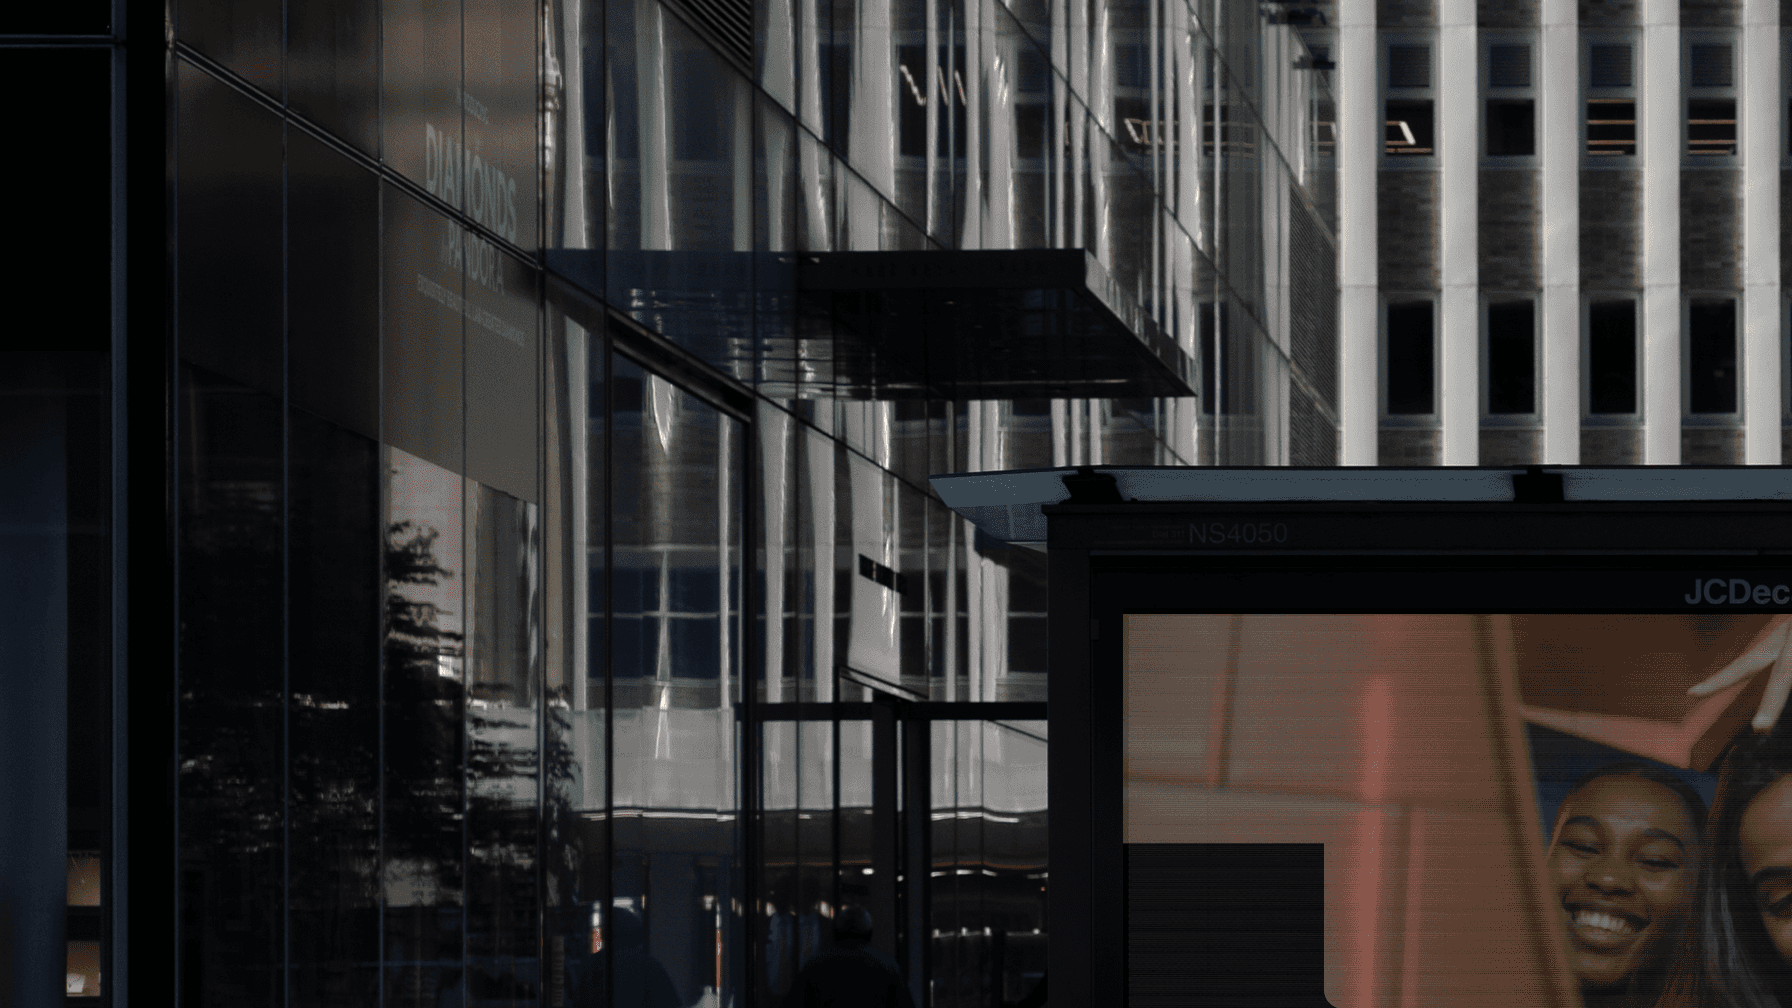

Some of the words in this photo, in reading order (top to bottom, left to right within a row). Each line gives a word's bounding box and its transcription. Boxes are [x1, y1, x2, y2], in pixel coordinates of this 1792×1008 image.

[425, 122, 518, 244] DIAMONDS
[447, 219, 505, 296] PANDORA
[1188, 522, 1288, 544] NS4050
